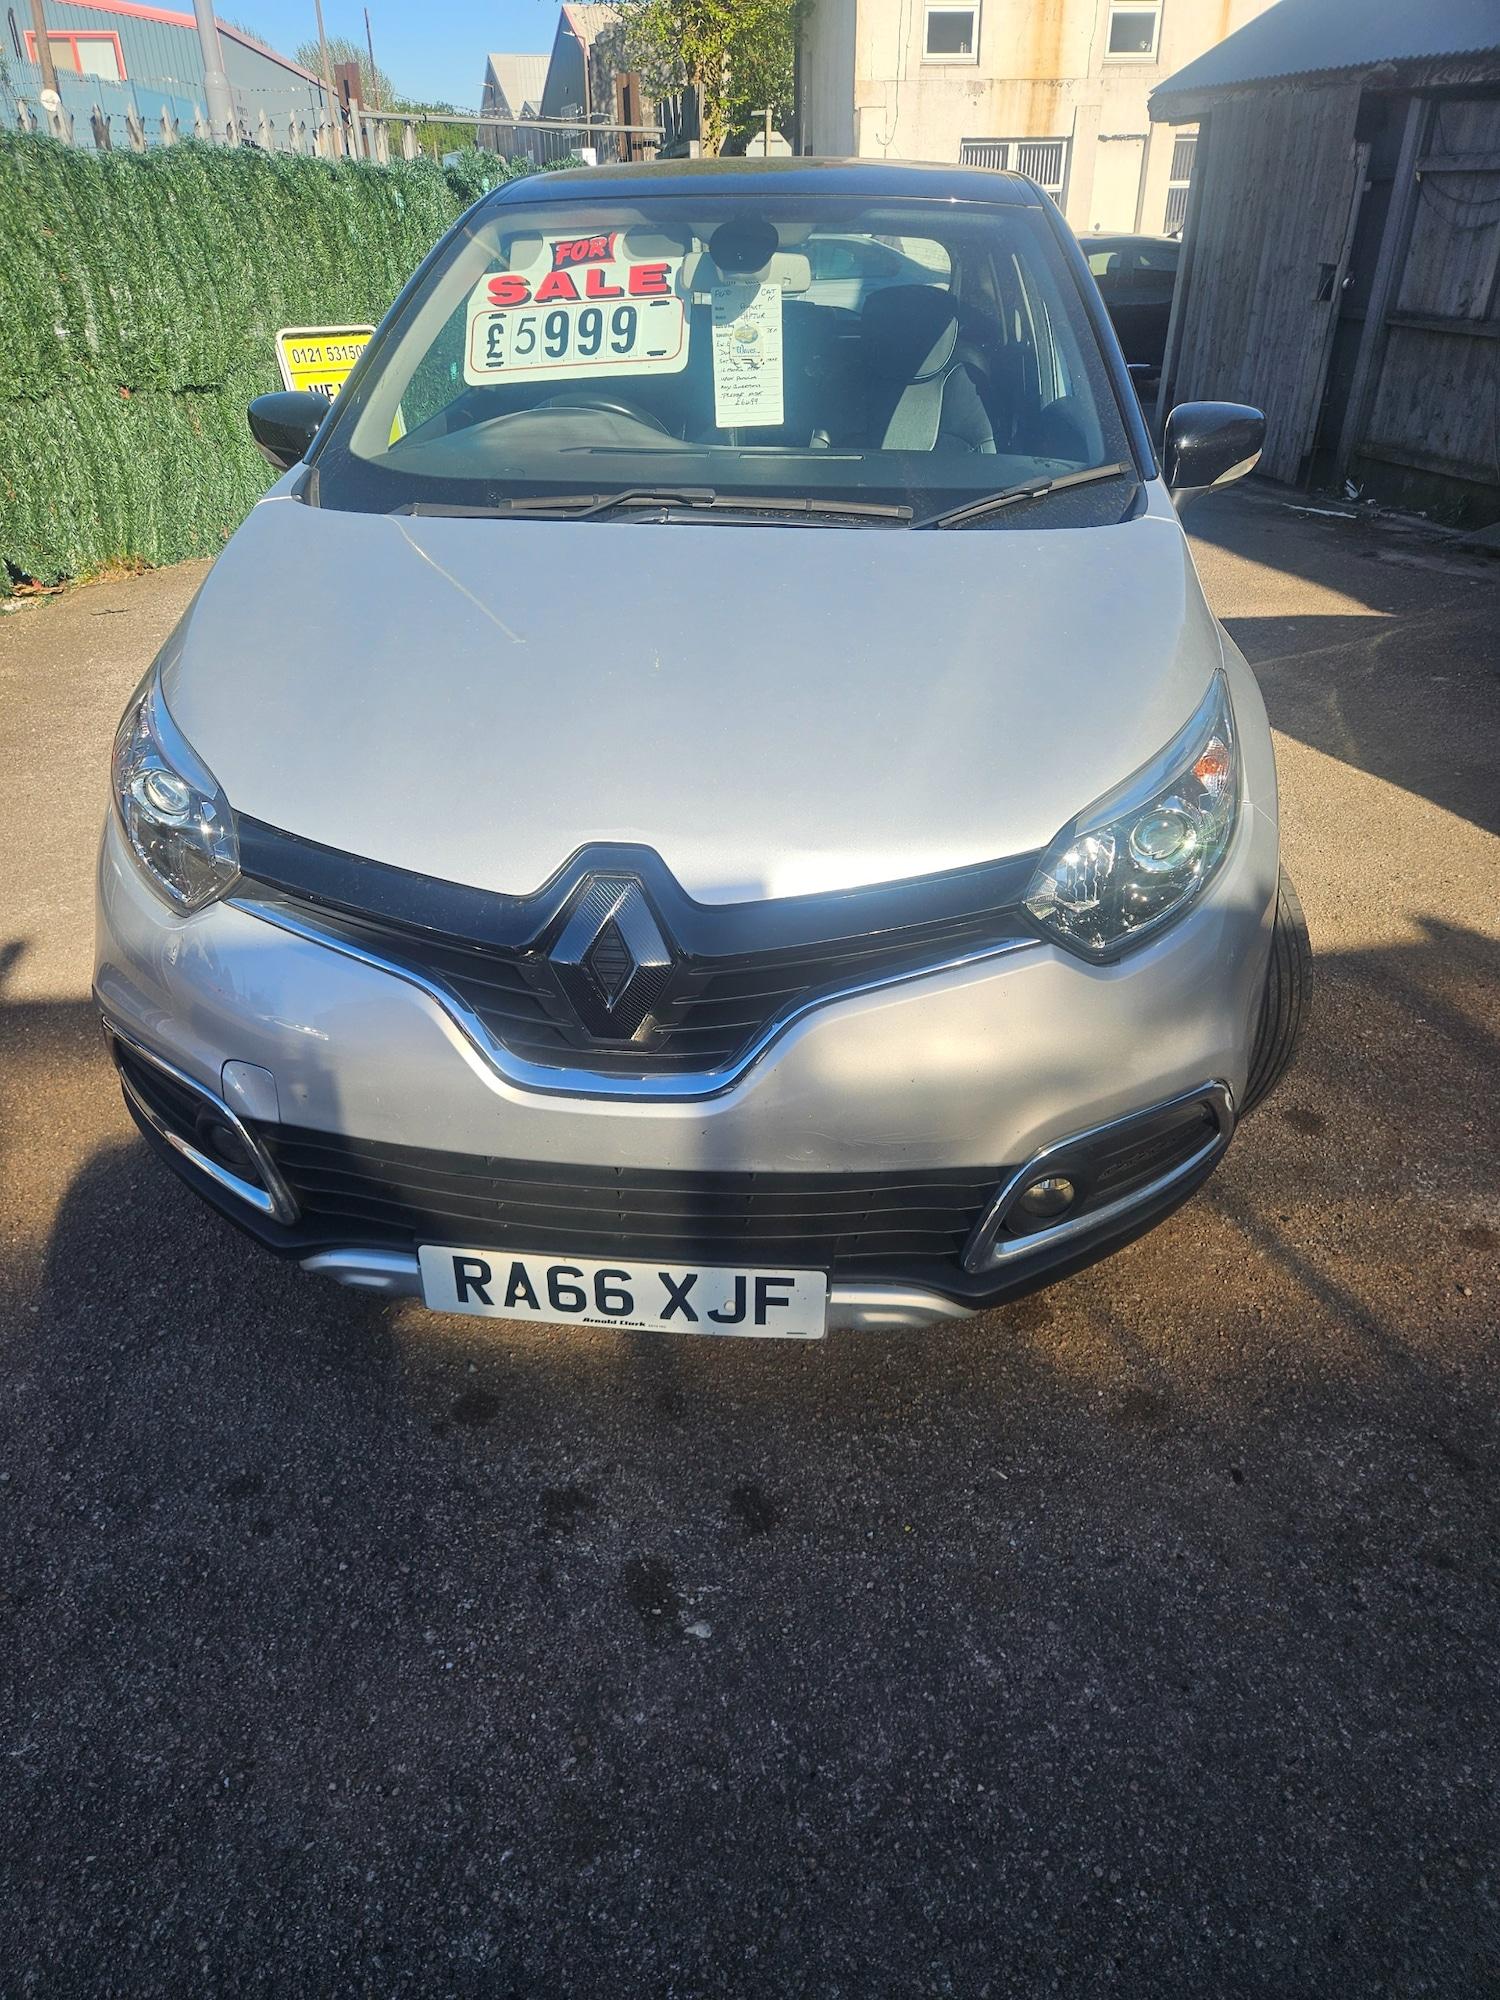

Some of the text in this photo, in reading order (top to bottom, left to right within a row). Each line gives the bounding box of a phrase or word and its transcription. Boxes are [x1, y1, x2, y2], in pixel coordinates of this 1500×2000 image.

[554, 236, 606, 265] FOR
[487, 263, 672, 307] SALE
[486, 305, 638, 359] £5999
[292, 347, 322, 364] 0121
[452, 1255, 796, 1326] RA66 XJF
[582, 1317, 617, 1325] Arnold
